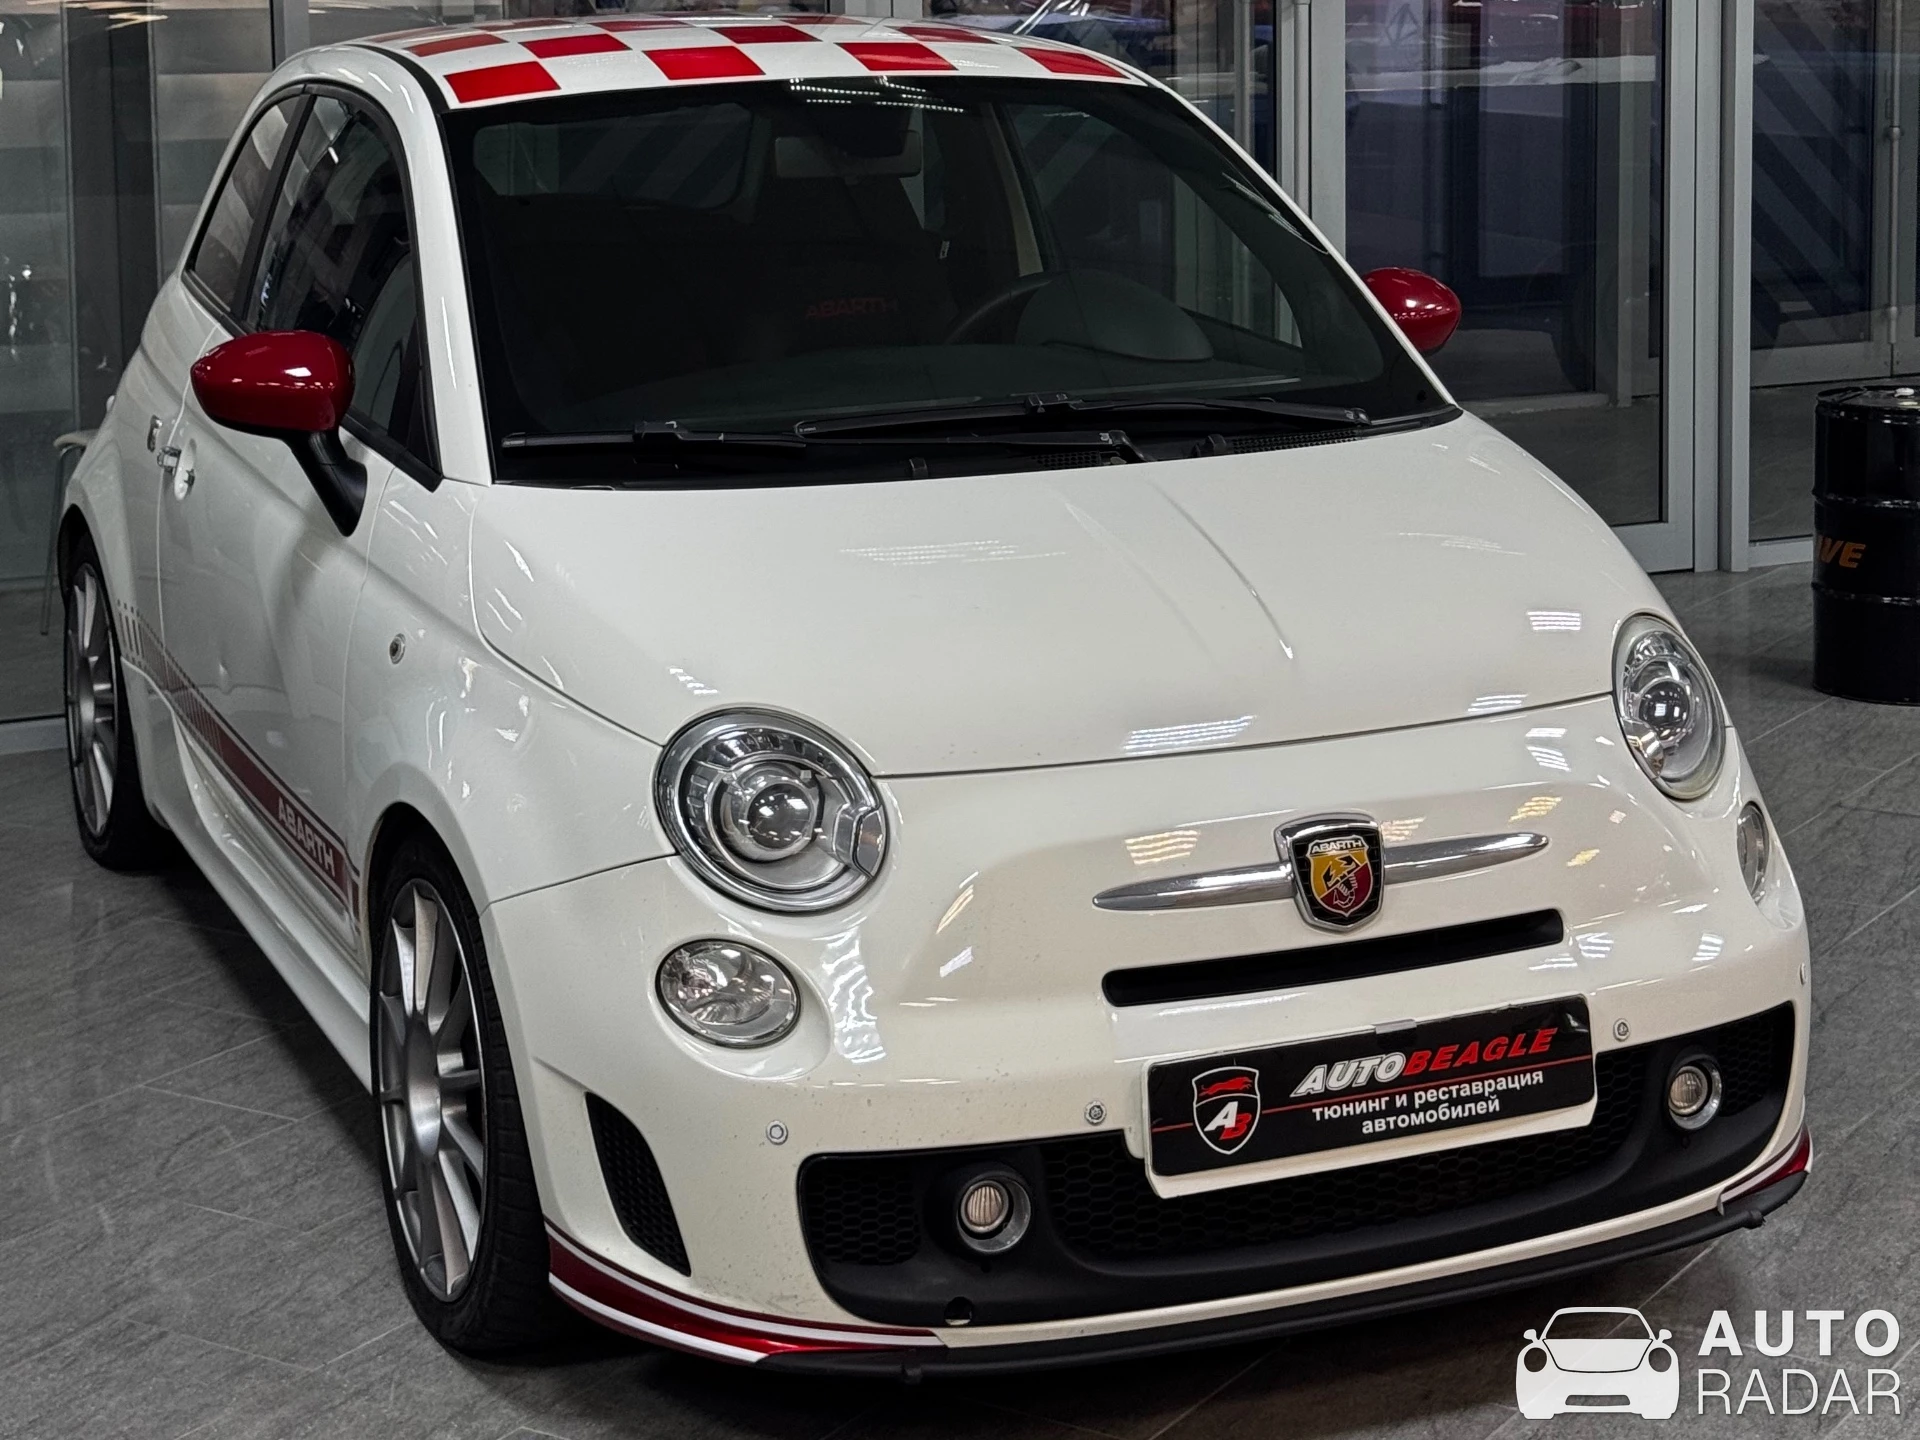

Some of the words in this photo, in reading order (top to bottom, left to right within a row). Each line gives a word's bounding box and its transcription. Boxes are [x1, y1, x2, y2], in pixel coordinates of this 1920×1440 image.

[278, 796, 335, 877] ABARTH
[1311, 840, 1362, 854] ABARTH
[1290, 1027, 1558, 1097] AUTOBEAGLE
[1312, 1095, 1390, 1121] тюнинг
[1396, 1093, 1408, 1108] и
[1414, 1070, 1544, 1108] реставрация
[1362, 1096, 1500, 1134] автомобилей
